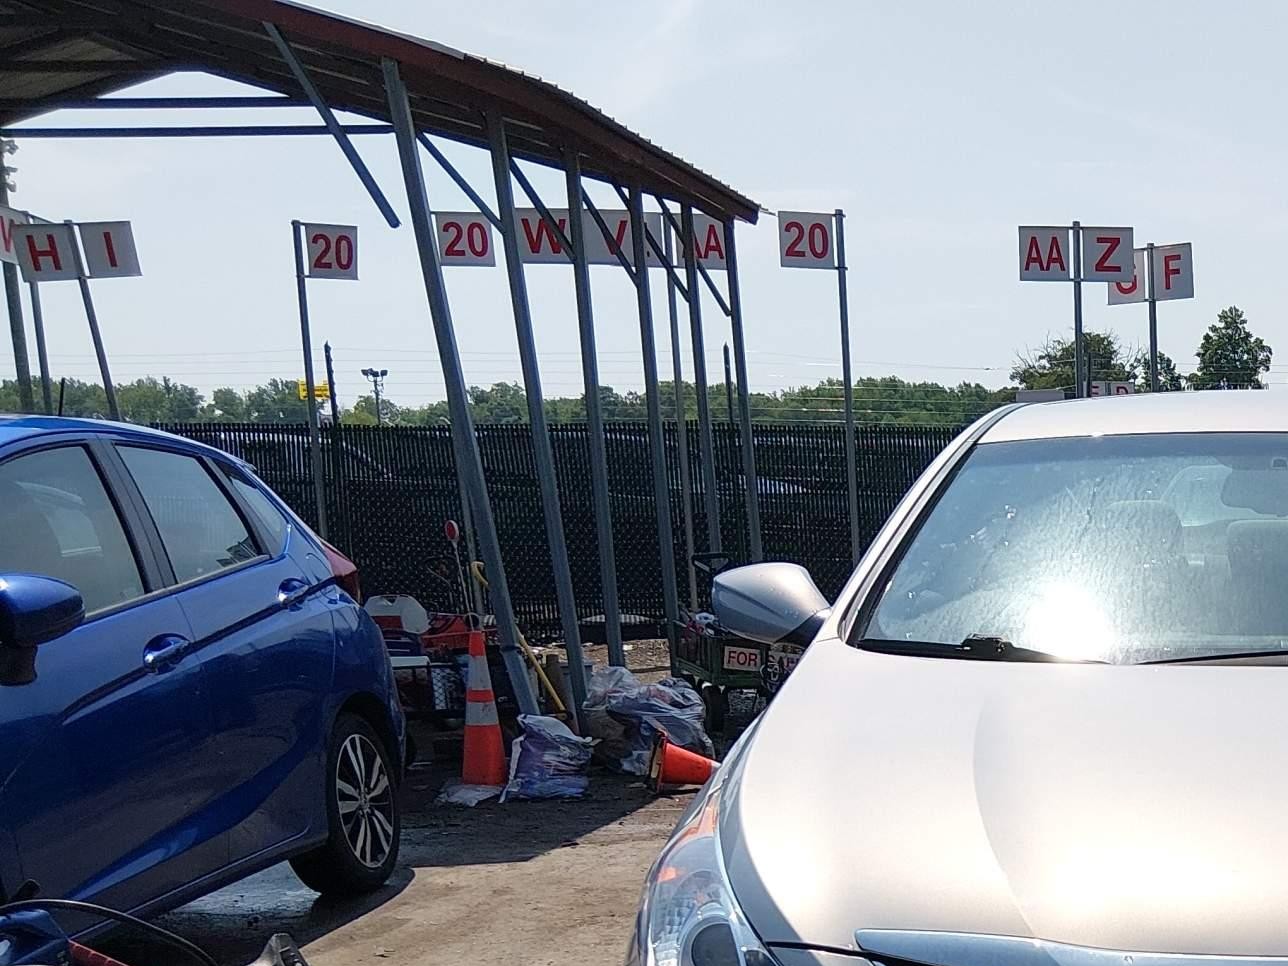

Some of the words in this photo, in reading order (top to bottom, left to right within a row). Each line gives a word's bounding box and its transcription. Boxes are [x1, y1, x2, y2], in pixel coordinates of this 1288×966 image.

[26, 234, 62, 271] H
[103, 232, 117, 267] I
[312, 234, 353, 270] 20
[441, 222, 489, 257] 20
[521, 218, 566, 254] W
[784, 221, 829, 259] 20
[1024, 236, 1066, 272] AA
[1095, 236, 1122, 272] Z
[1164, 254, 1182, 290] F
[727, 650, 758, 667] FOR
